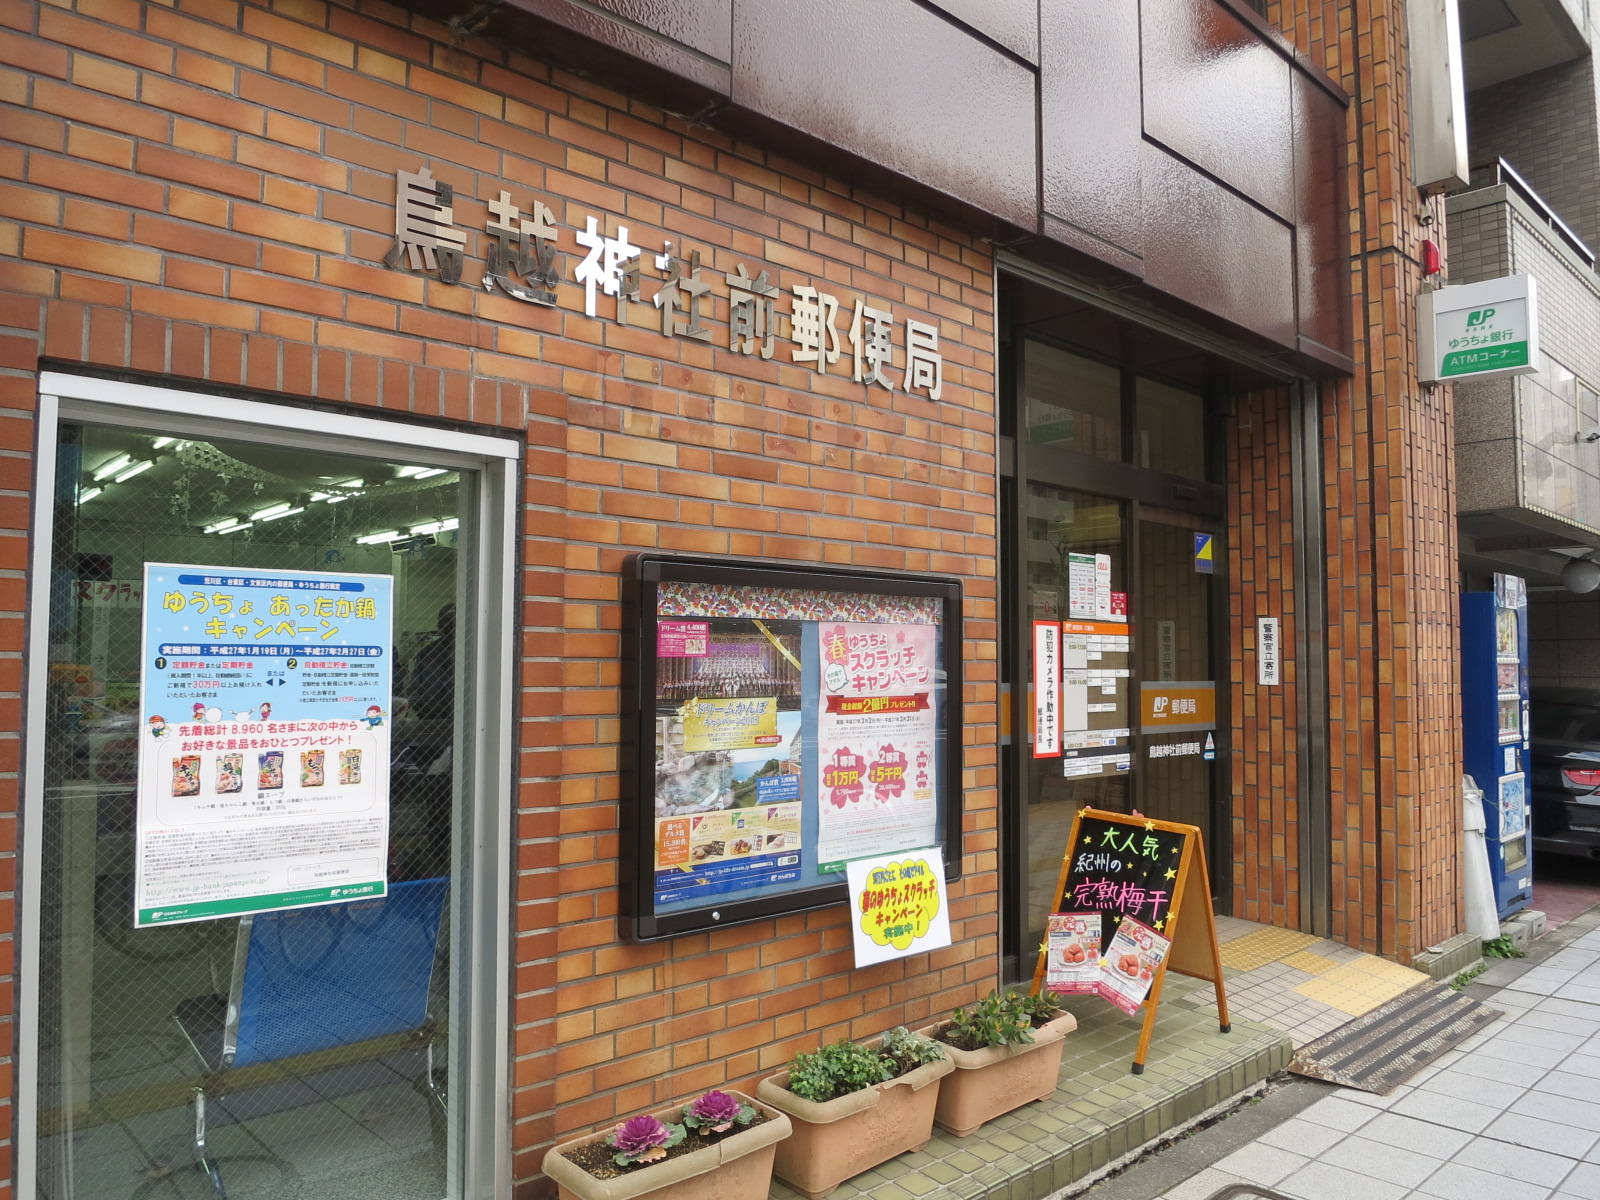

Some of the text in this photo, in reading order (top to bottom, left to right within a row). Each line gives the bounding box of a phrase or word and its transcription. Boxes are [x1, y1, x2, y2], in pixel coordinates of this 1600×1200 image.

[384, 166, 943, 401] 鳥越神社前郵便局
[1448, 329, 1513, 349] ゆうちょ銀行
[1450, 348, 1520, 366] ATMコーナー
[163, 590, 376, 620] ゆうちょ あったか鍋
[205, 616, 339, 641] キャンペーン
[849, 634, 887, 648] ゆうちょ
[1263, 623, 1274, 680] 警察官立寄所
[850, 646, 916, 672] スクラッチ
[852, 665, 929, 692] キャンペーン
[1045, 629, 1054, 750] 防犯カメラ作動中です
[1171, 698, 1196, 715] 郵便局
[179, 725, 228, 737] 先着総計
[267, 721, 358, 734] 名さまに次の中から
[832, 770, 859, 787] 1万円
[876, 766, 903, 782] 5千円
[1100, 827, 1160, 861] 大人気
[1074, 853, 1121, 873] 紀州の
[1073, 877, 1168, 921] 完熟梅干
[875, 904, 923, 927] キャンペーン
